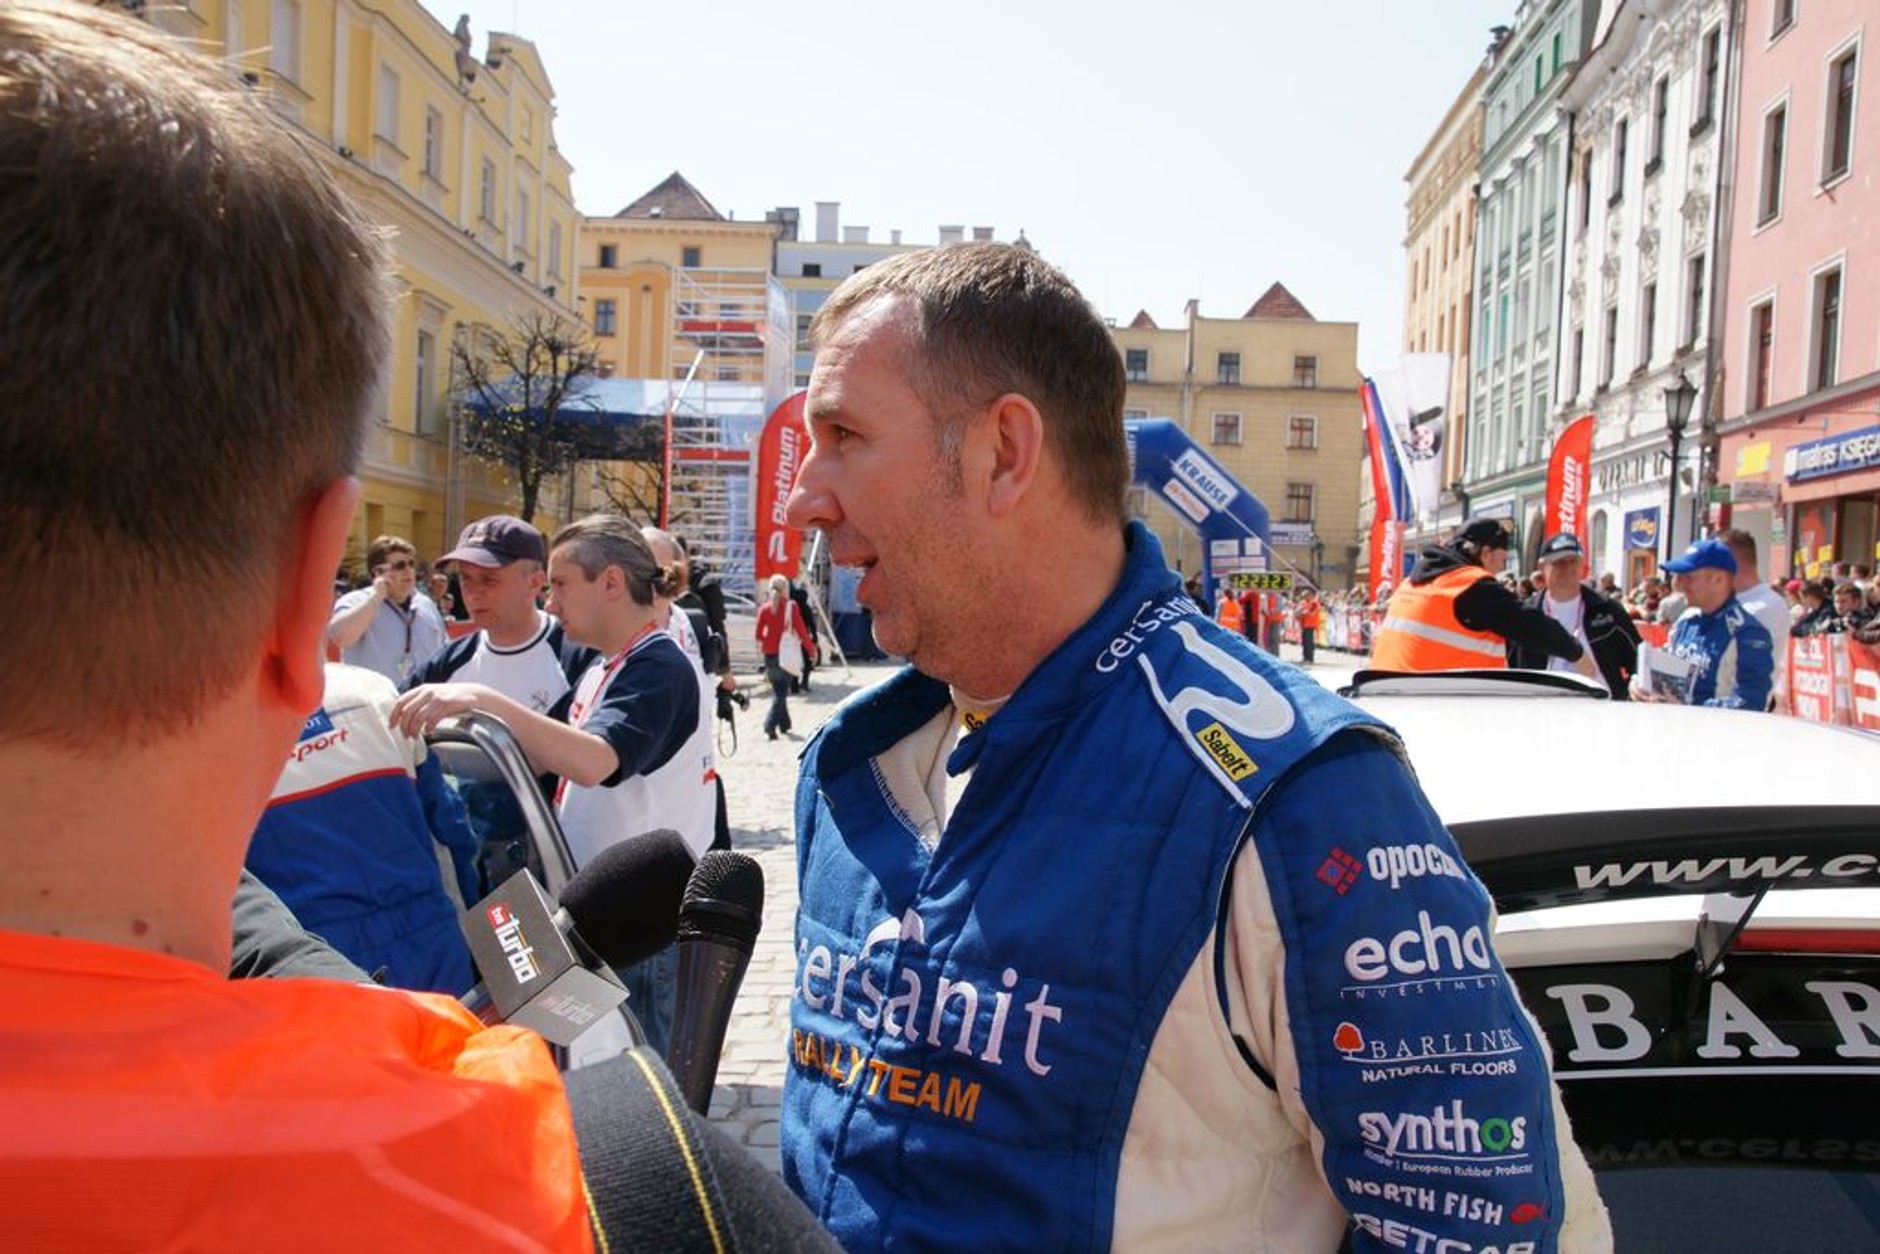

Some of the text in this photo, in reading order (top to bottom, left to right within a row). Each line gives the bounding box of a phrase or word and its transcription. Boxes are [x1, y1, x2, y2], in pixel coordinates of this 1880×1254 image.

[1179, 459, 1228, 504] KRAUSE
[288, 727, 349, 763] port
[1203, 729, 1250, 776] Sabelt
[495, 912, 538, 984] turbo
[1344, 910, 1491, 981] echo
[796, 937, 1062, 1077] ersanit
[793, 1028, 982, 1123] RALLY TEAM
[1362, 1059, 1517, 1083] NATURAL FLOORS
[1358, 1099, 1527, 1157] synthos
[1402, 1161, 1452, 1176] European
[1454, 1165, 1493, 1177] Rubber
[1345, 1177, 1503, 1226] NORTH FISH
